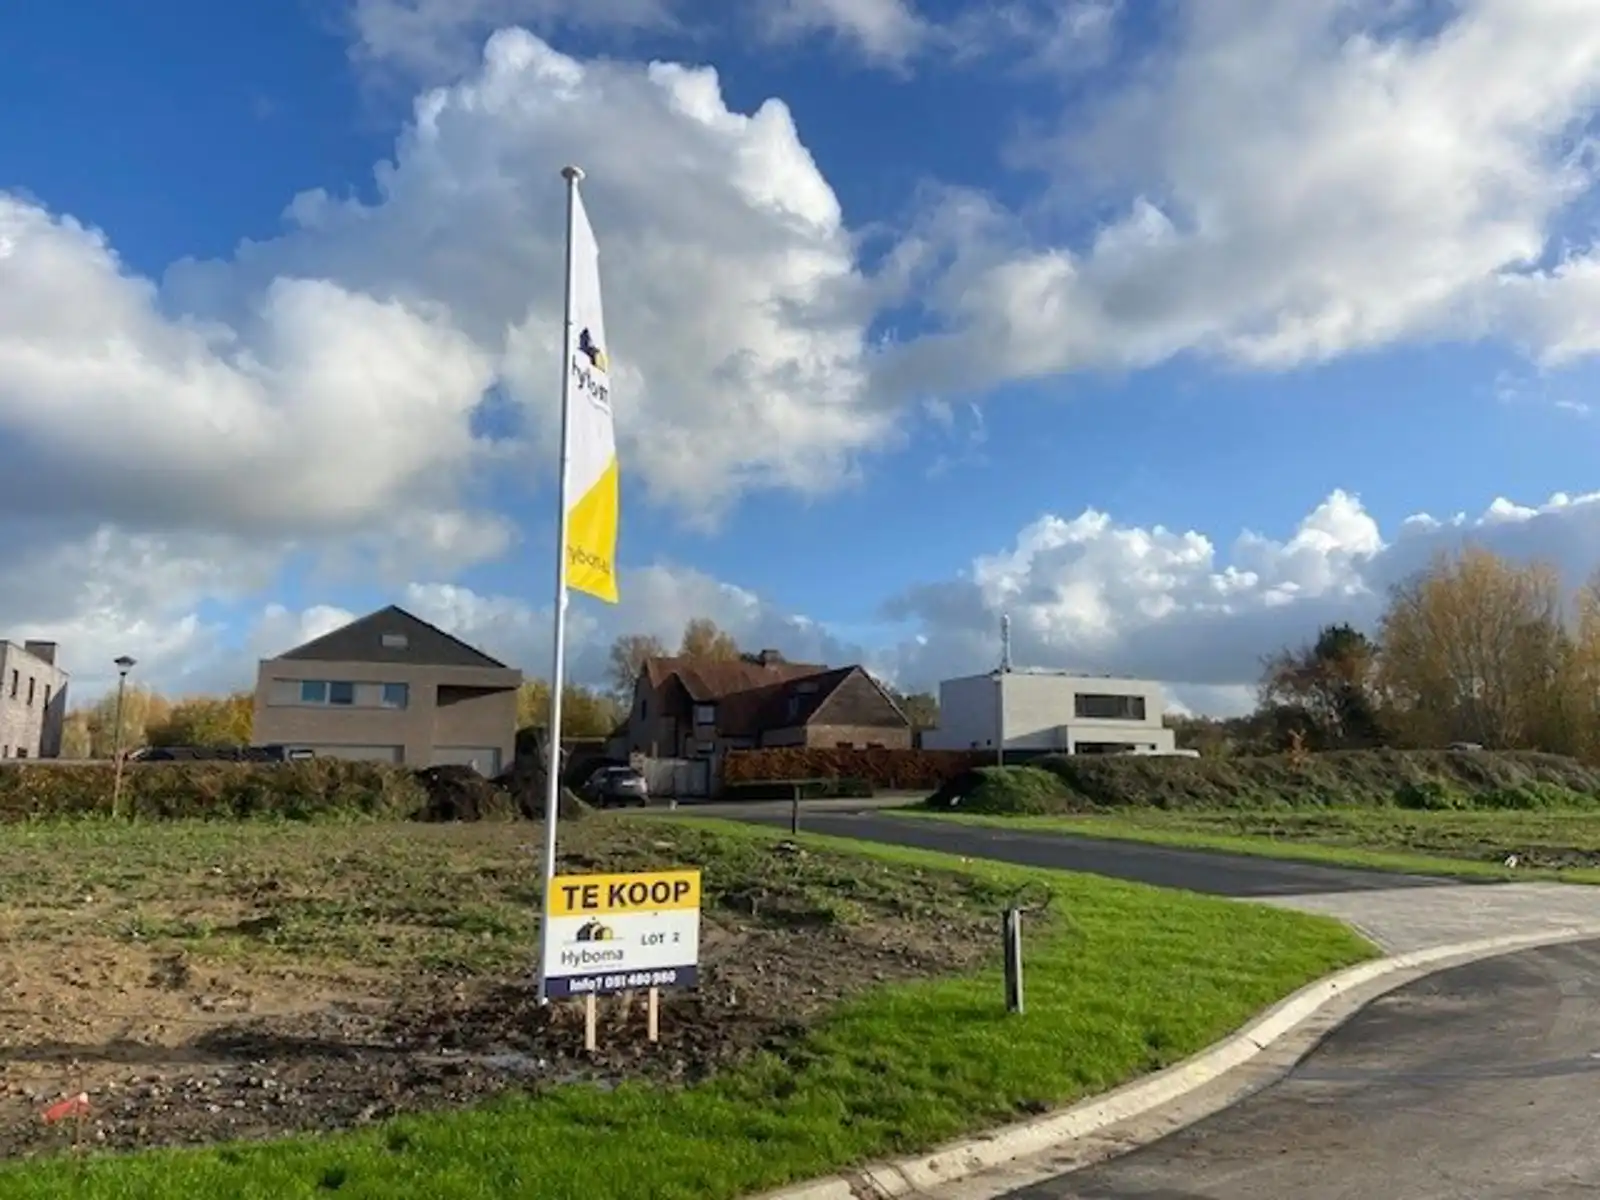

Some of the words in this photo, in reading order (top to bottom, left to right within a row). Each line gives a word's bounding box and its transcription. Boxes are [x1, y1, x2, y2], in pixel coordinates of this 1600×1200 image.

[561, 884, 599, 910] TE
[608, 880, 691, 908] KOOP
[640, 933, 665, 946] LOT
[561, 949, 625, 968] Hyboma
